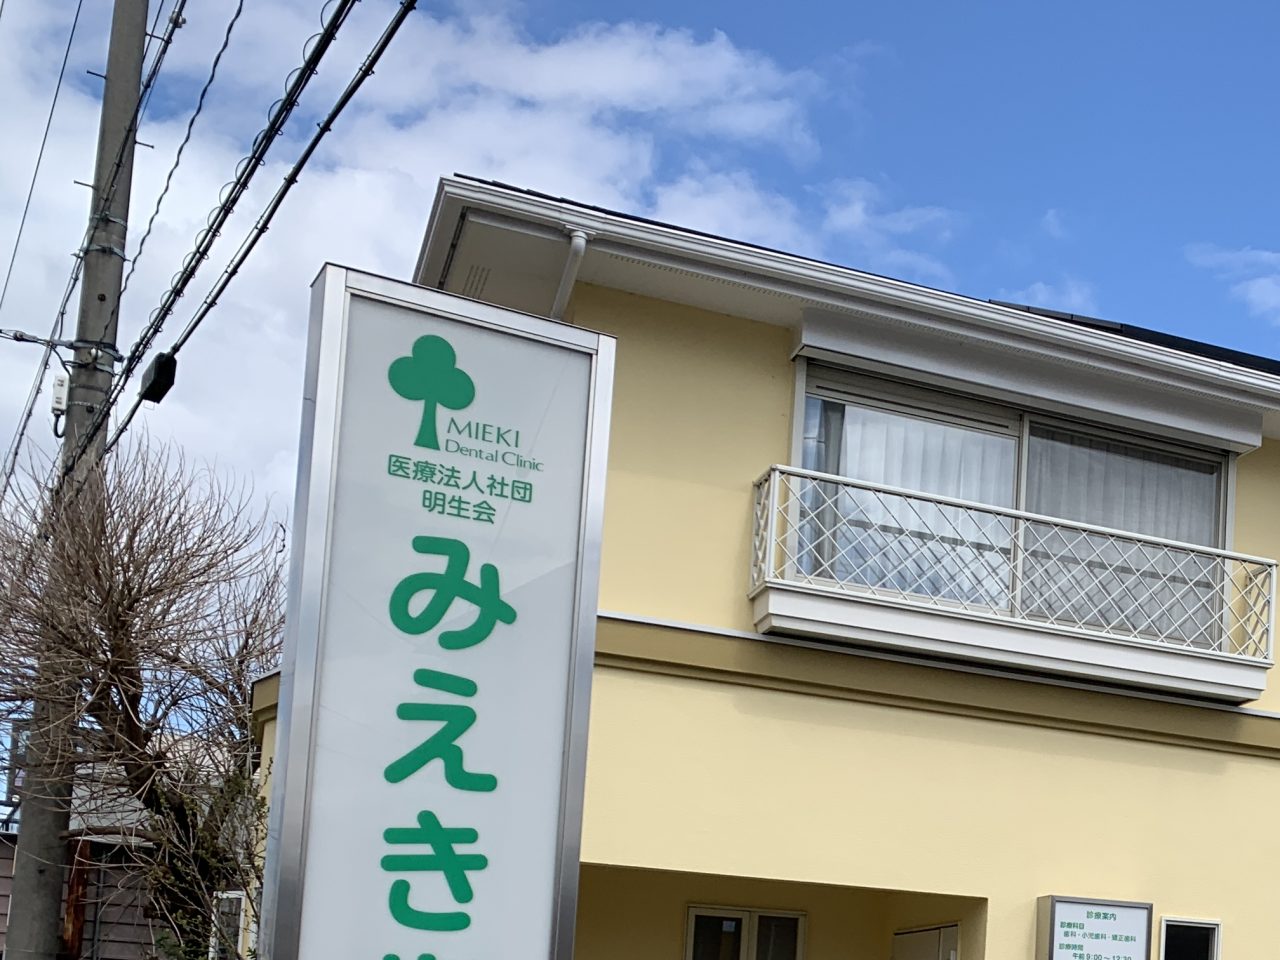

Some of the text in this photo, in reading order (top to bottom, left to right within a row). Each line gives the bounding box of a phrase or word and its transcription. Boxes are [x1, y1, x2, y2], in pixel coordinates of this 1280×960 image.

[446, 417, 521, 448] MIEKI
[445, 438, 544, 472] Dental Clinic
[387, 454, 533, 503] 医療法人社団
[421, 490, 496, 524] 明生会
